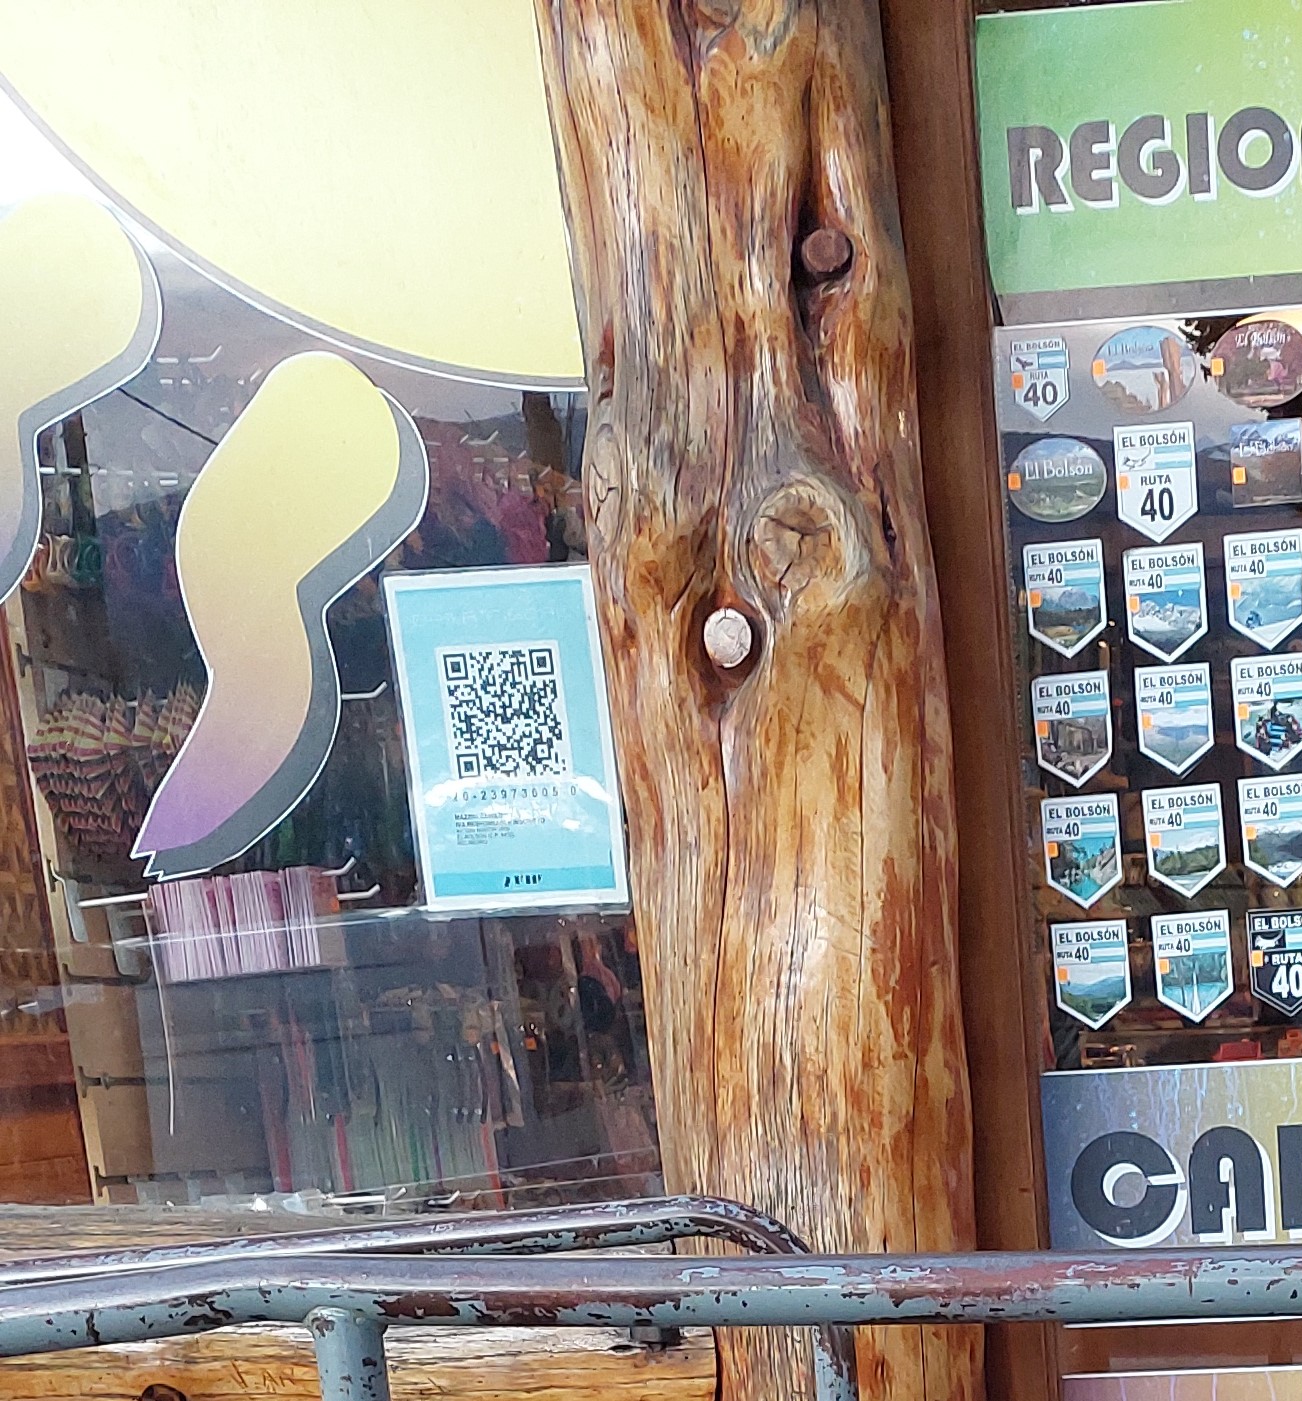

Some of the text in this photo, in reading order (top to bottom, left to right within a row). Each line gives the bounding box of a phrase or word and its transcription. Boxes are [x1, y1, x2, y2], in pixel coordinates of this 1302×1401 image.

[1014, 343, 1024, 351] EL
[1030, 371, 1049, 380] RUTA
[1023, 380, 1058, 407] 40
[1122, 432, 1186, 448] EL BOLSÓN
[1025, 457, 1093, 480] El Bolsón
[1140, 474, 1172, 486] RUTA
[1140, 487, 1175, 522] 40
[1232, 537, 1297, 557] EL BOLSÓN
[1031, 547, 1094, 566] EL BOLSÓN
[1131, 553, 1195, 571] EL BOLSÓN
[1249, 559, 1265, 575] 40
[1047, 568, 1063, 584] 40
[1147, 573, 1163, 590] 40
[1240, 667, 1254, 679] EL
[1143, 677, 1157, 688] EL
[1256, 681, 1271, 697] 40
[1038, 686, 1053, 698] EL
[1158, 690, 1173, 706] 40
[1054, 700, 1071, 716] 40
[1246, 788, 1261, 800] EL
[1151, 798, 1165, 810] EL
[1262, 801, 1278, 817] 40
[1048, 808, 1062, 819] EL
[1167, 811, 1182, 828] 40
[1064, 822, 1080, 838] 40
[1160, 917, 1221, 936] EL BOLSÓN
[1254, 917, 1269, 930] EL
[1059, 927, 1120, 944] EL BOLSÓN
[1074, 946, 1089, 961] 40
[1175, 938, 1191, 953] 40
